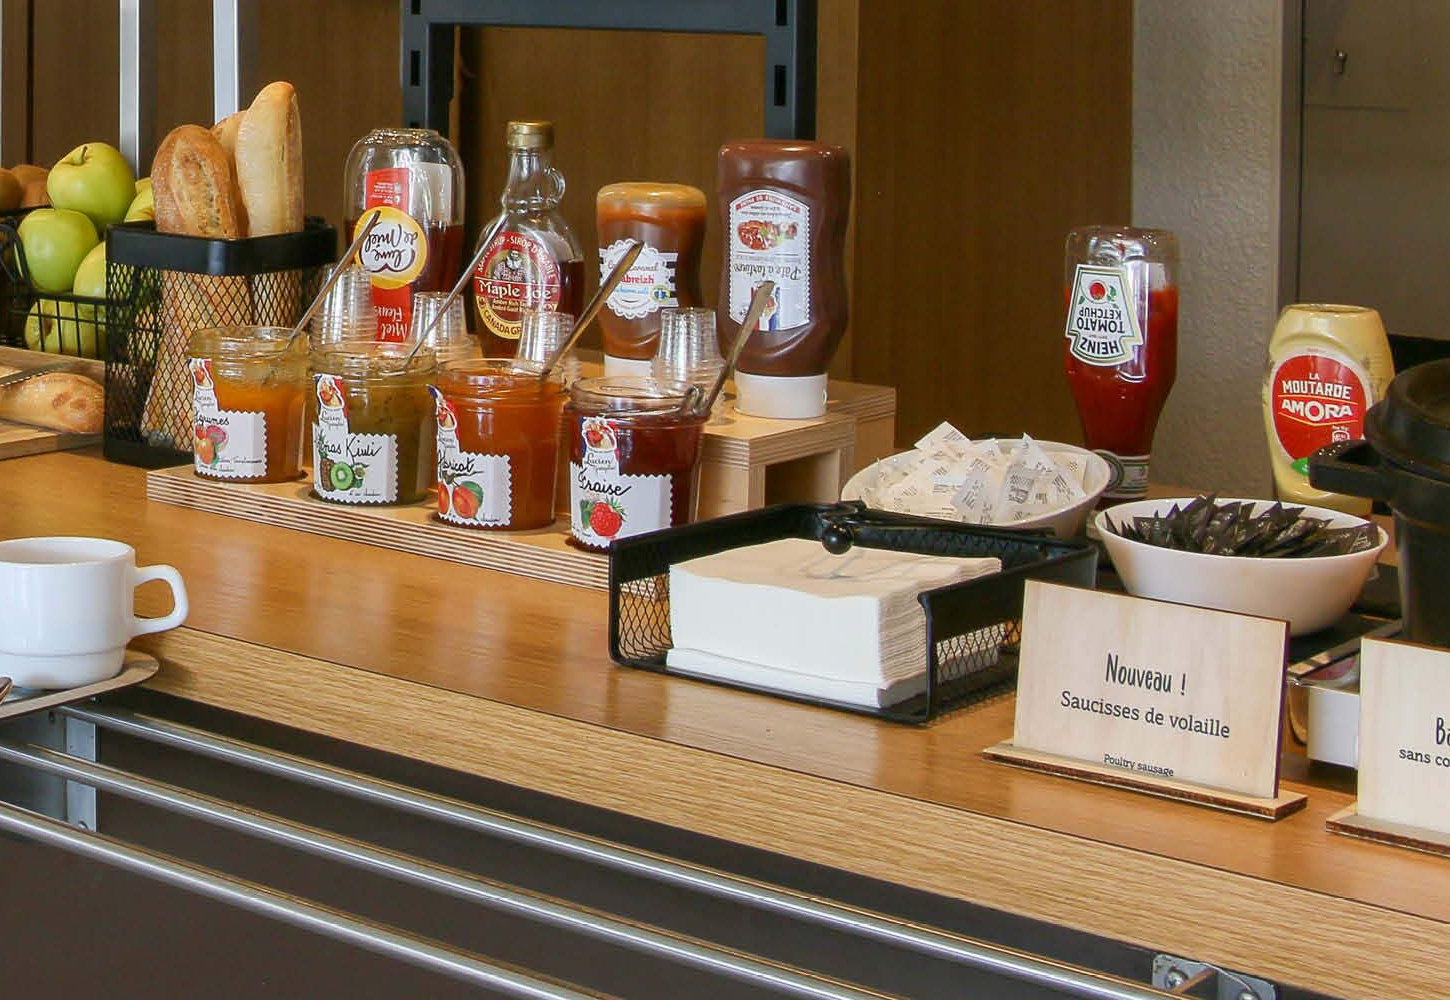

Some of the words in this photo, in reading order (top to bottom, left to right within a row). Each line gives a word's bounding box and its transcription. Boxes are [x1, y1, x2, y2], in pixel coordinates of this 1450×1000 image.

[478, 279, 521, 298] Maple
[1078, 306, 1122, 320] KETCHUP
[381, 322, 408, 340] Miel
[1076, 317, 1125, 334] TOMATO
[1079, 336, 1120, 355] HEINZ
[1308, 372, 1320, 380] LA
[1282, 379, 1353, 400] MOUTARDE
[1281, 399, 1354, 422] AMORA
[577, 467, 632, 496] Fraise
[1105, 652, 1173, 694] Nouveau
[1060, 690, 1141, 721] Saucisses
[1144, 707, 1165, 726] de
[1168, 714, 1231, 739] volaille
[1103, 753, 1136, 770] Poultry
[1137, 760, 1175, 777] sausage
[1398, 748, 1432, 764] sans
